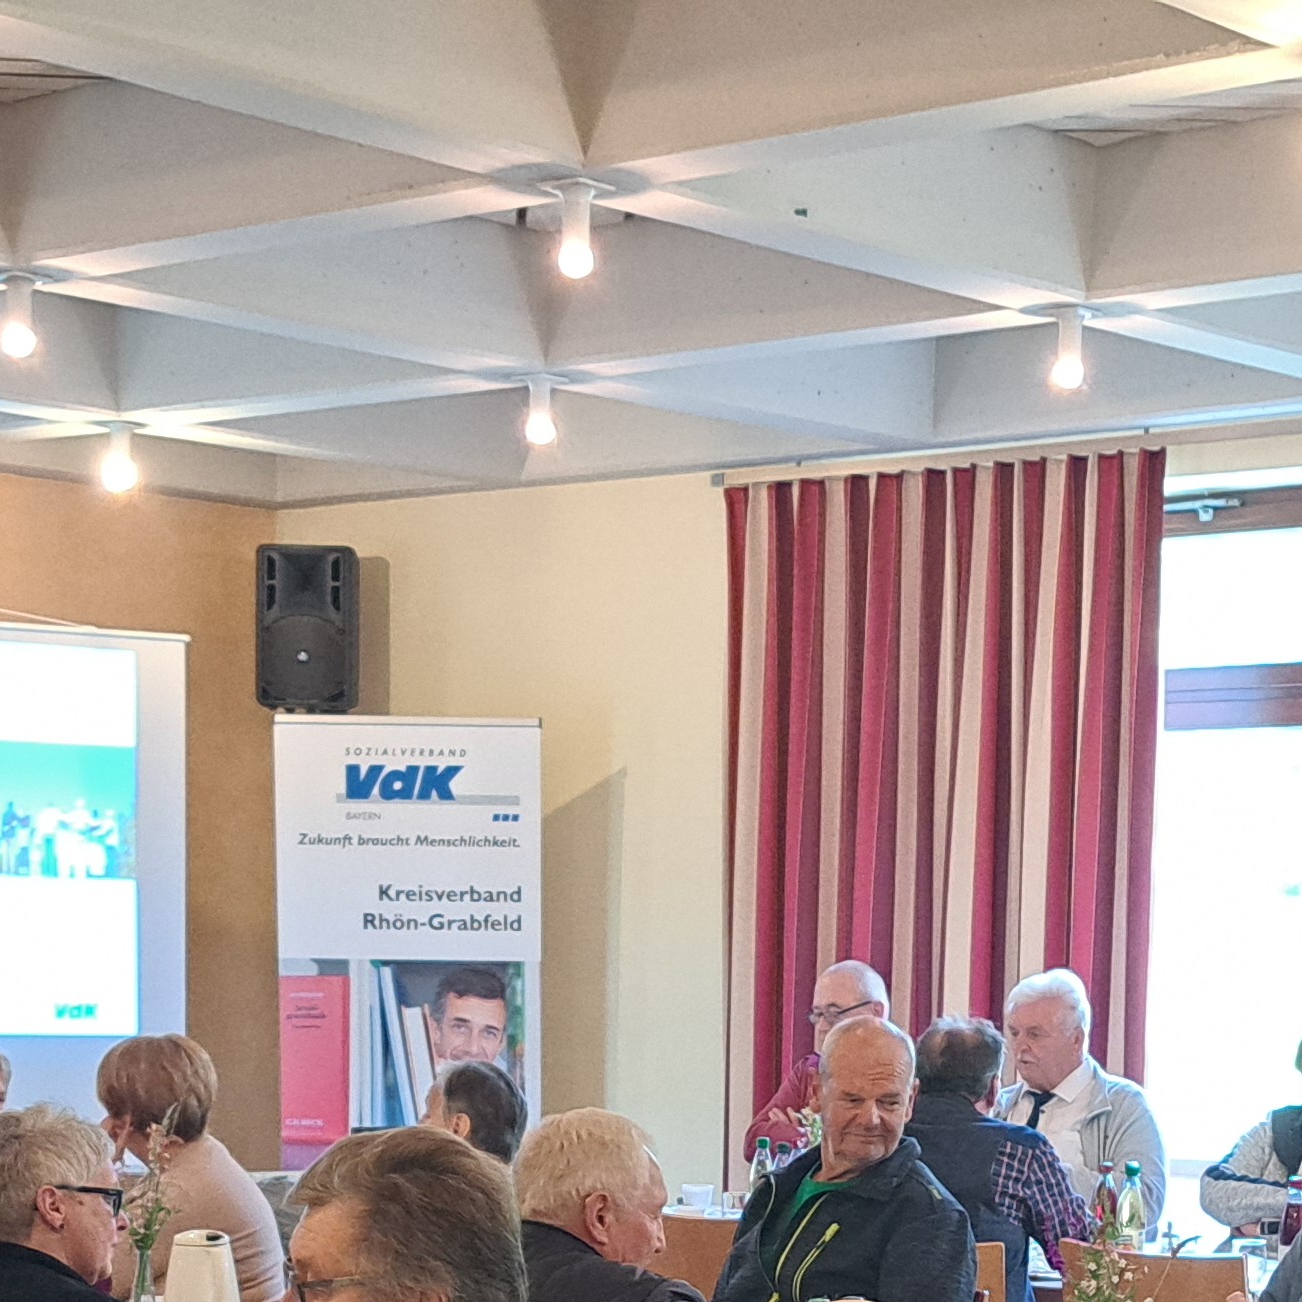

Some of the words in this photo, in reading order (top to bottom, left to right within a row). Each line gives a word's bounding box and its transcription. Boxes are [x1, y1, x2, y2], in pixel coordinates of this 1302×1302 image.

[345, 746, 467, 758] SOZIALVERBAND
[345, 763, 465, 802] VdK
[345, 811, 381, 821] BAYERN
[297, 832, 353, 849] Zukunft
[357, 834, 410, 847] braucht
[414, 835, 521, 849] Menschlichkeit.
[378, 883, 522, 903] Kreisverband
[362, 912, 522, 932] Rhön-Grabfeld
